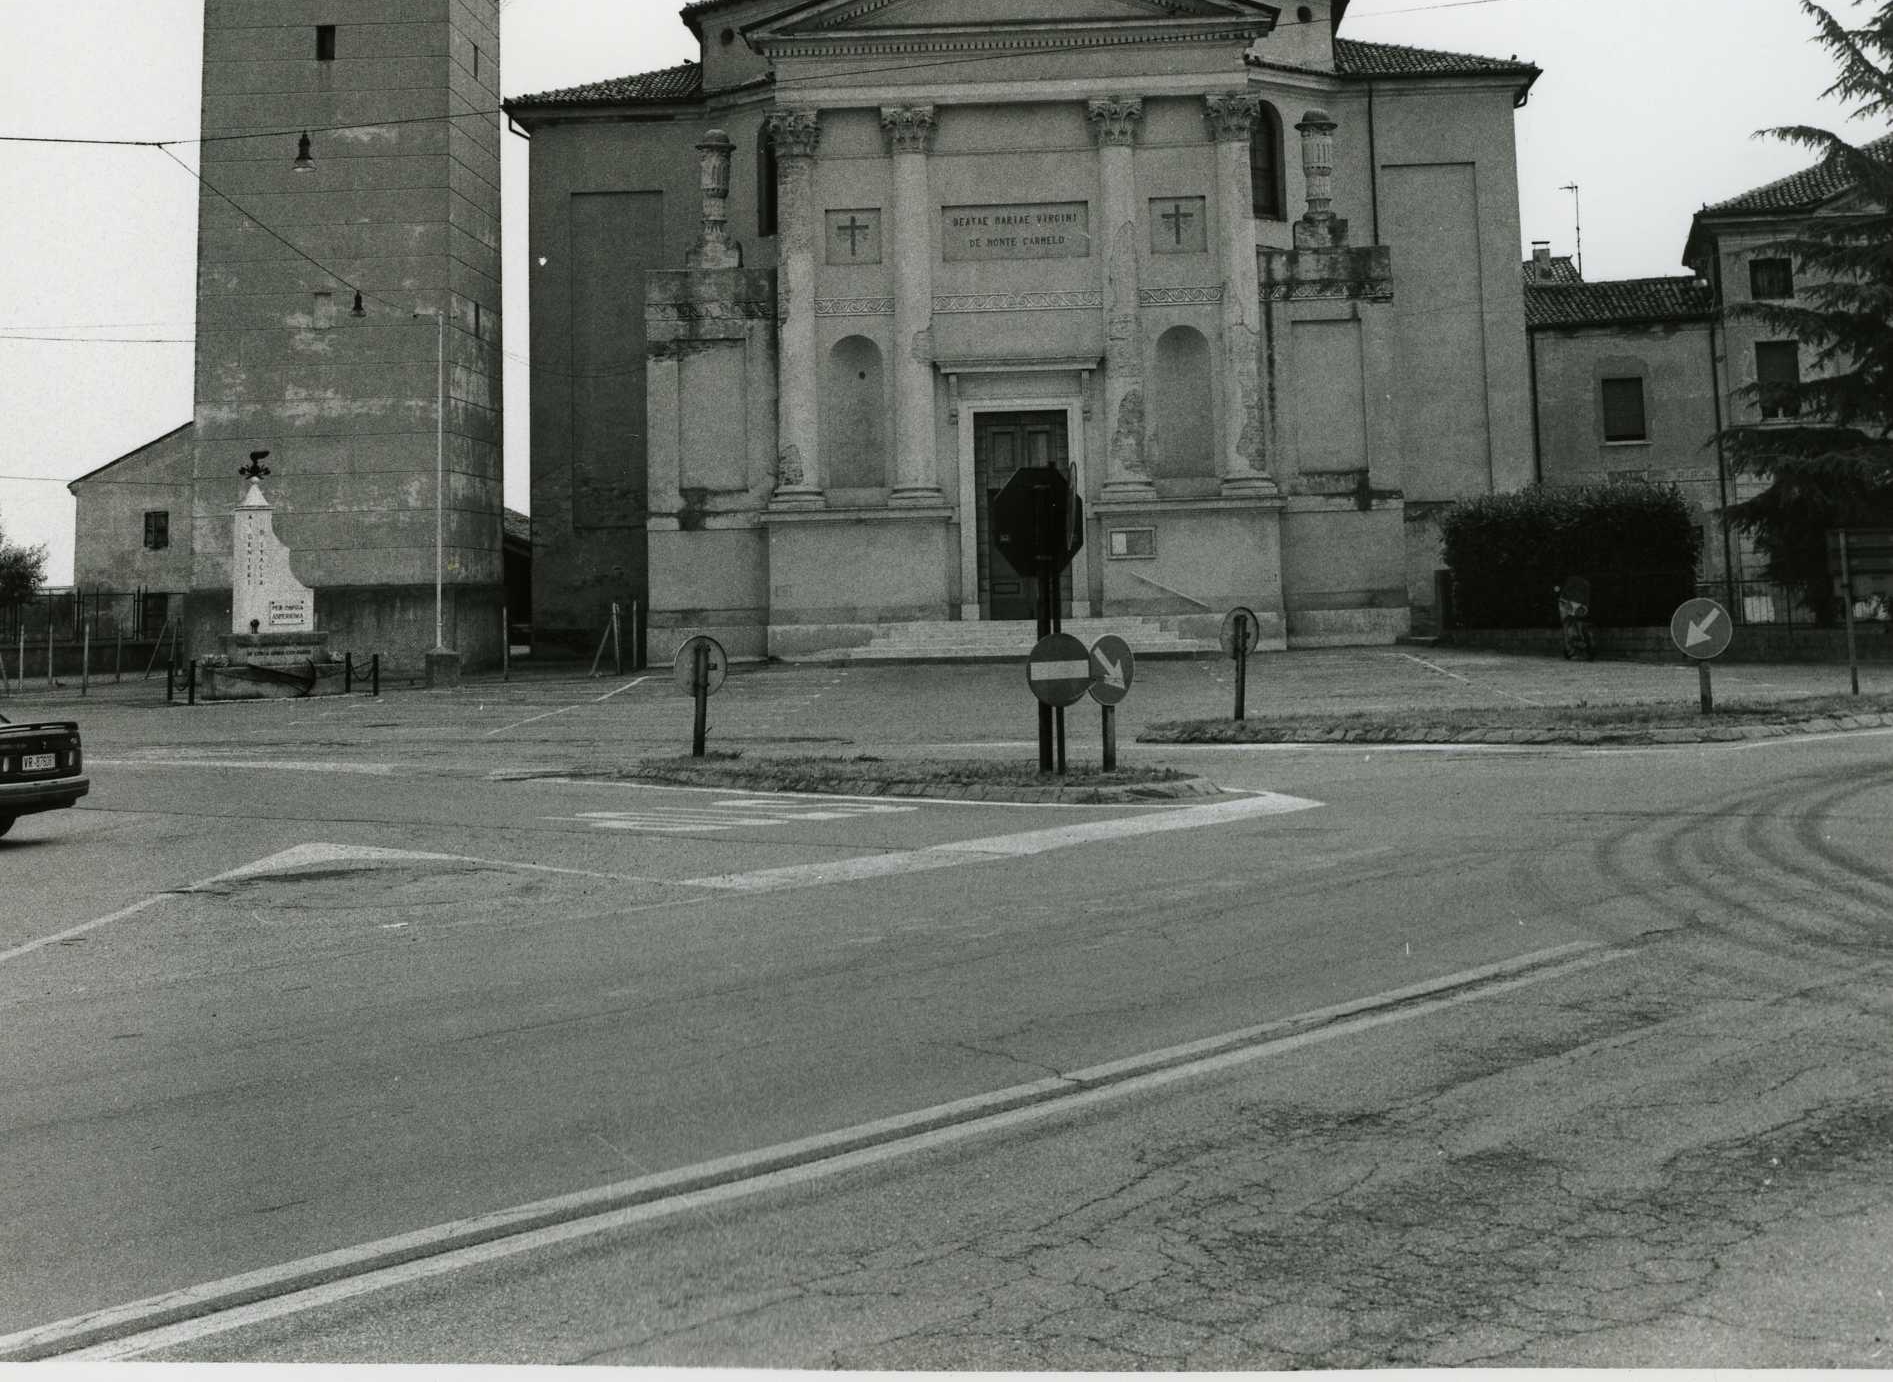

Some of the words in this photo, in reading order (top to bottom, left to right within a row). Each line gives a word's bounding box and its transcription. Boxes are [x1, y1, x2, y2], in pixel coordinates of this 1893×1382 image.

[953, 216, 989, 227] BEATAE
[995, 215, 1030, 225] MARIAE
[1036, 213, 1077, 224] VIRGINI
[969, 238, 981, 248] DE
[987, 237, 1017, 247] MONTE
[1023, 236, 1065, 246] CARMELO
[537, 799, 919, 831] STOP
